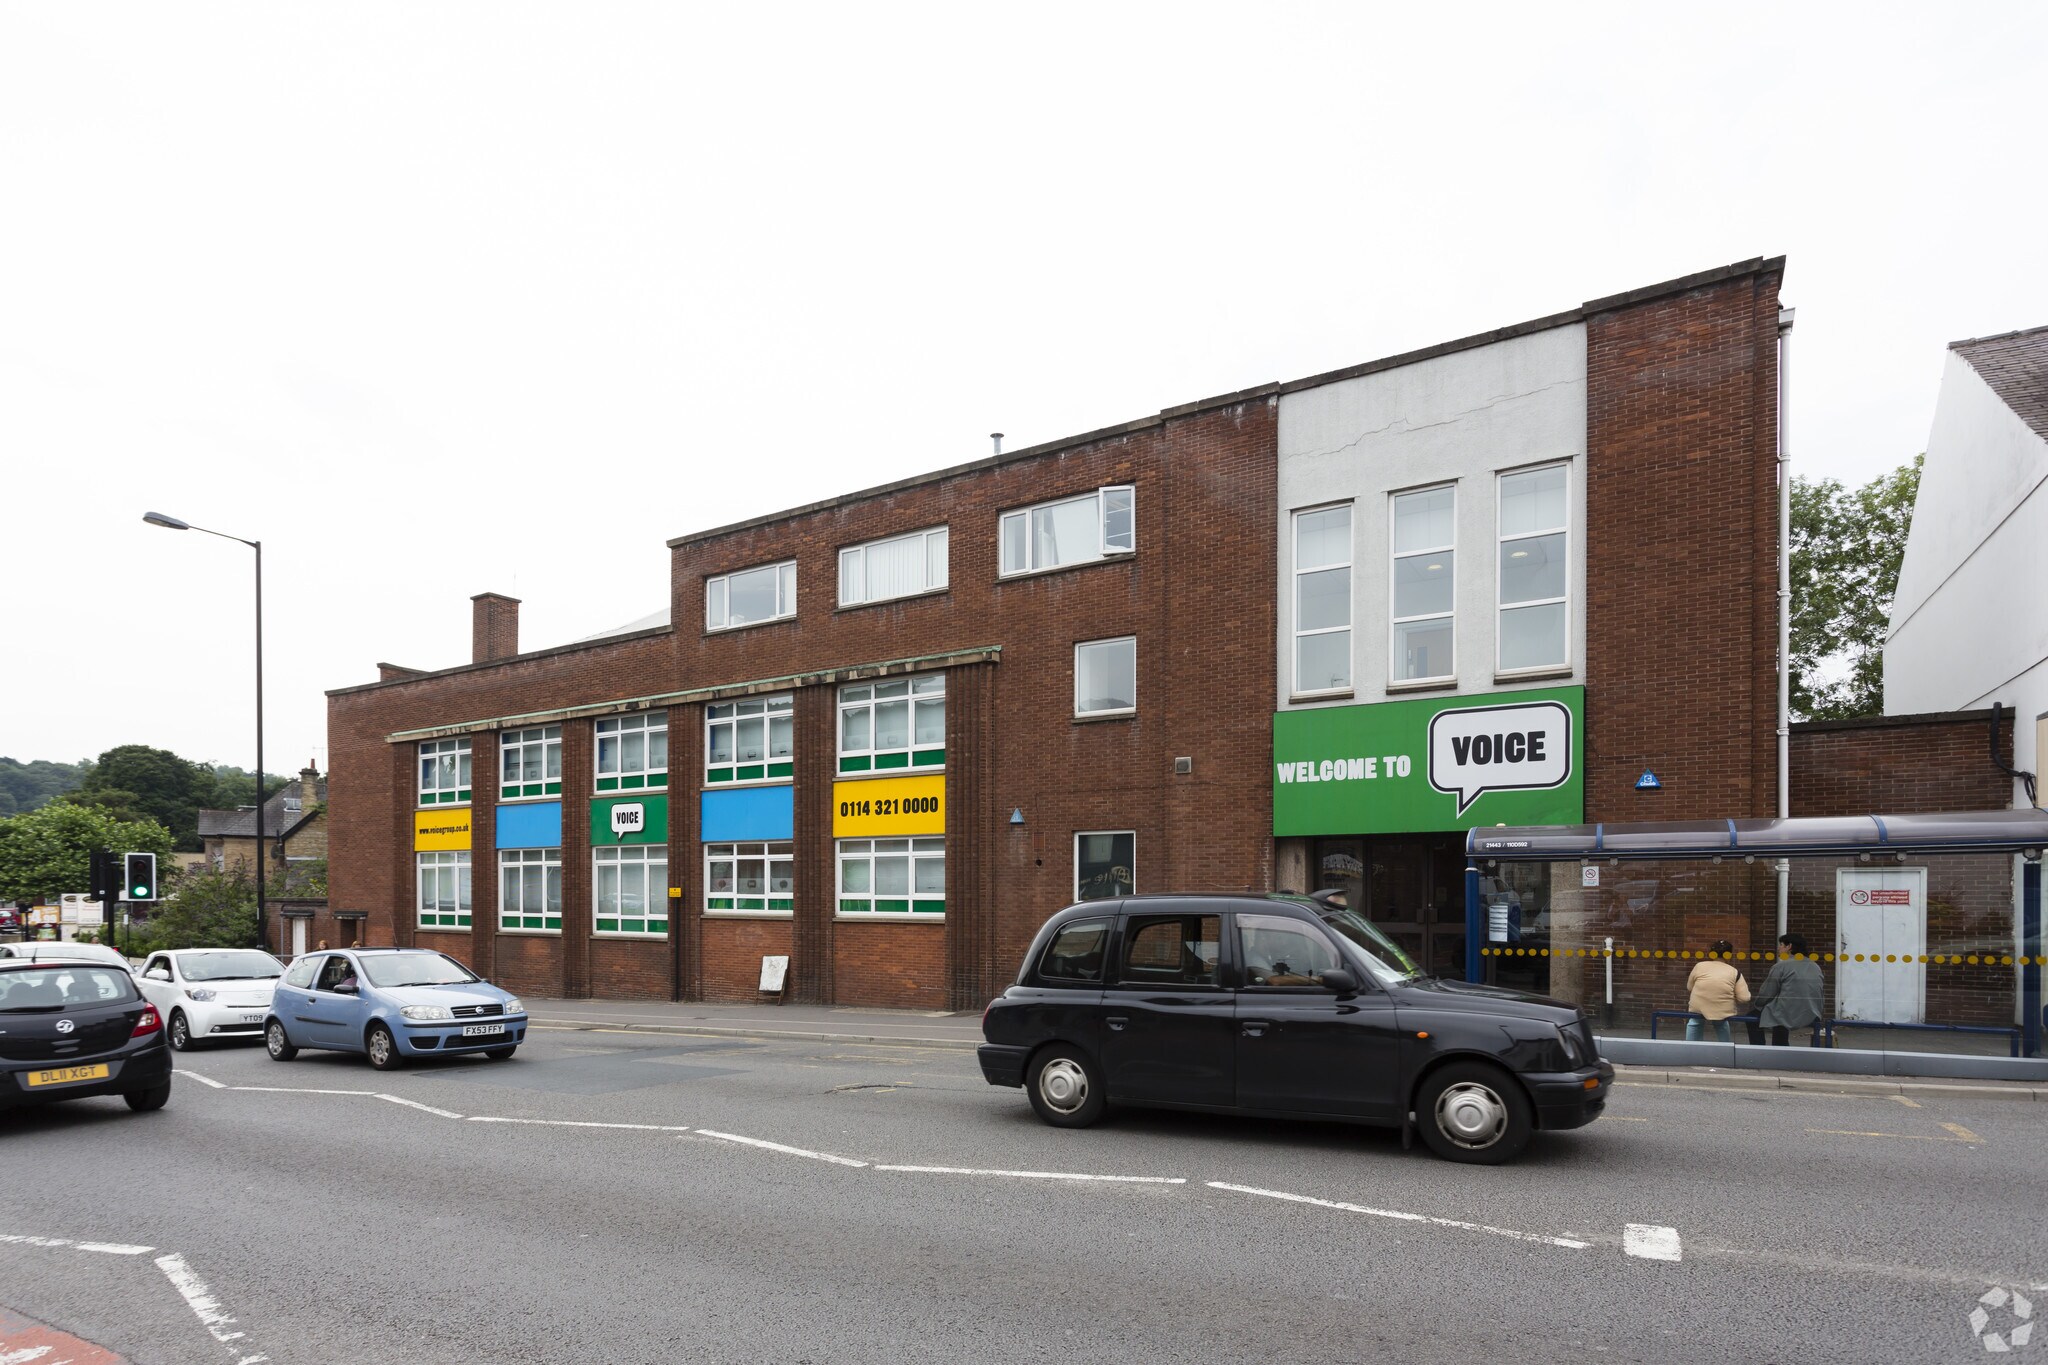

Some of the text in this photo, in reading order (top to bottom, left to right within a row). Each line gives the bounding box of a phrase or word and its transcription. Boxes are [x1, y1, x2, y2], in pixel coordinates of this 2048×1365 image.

[1451, 731, 1546, 766] VOICE
[1277, 755, 1411, 783] WELCOME TO
[840, 796, 938, 817] 0114 321 0000
[616, 811, 639, 824] VOICE
[419, 823, 469, 835] www.voicegroup.co.uk
[243, 1014, 264, 1022] YT09
[465, 1024, 503, 1035] FX53 FFY
[40, 1066, 96, 1082] DL11 XGT
